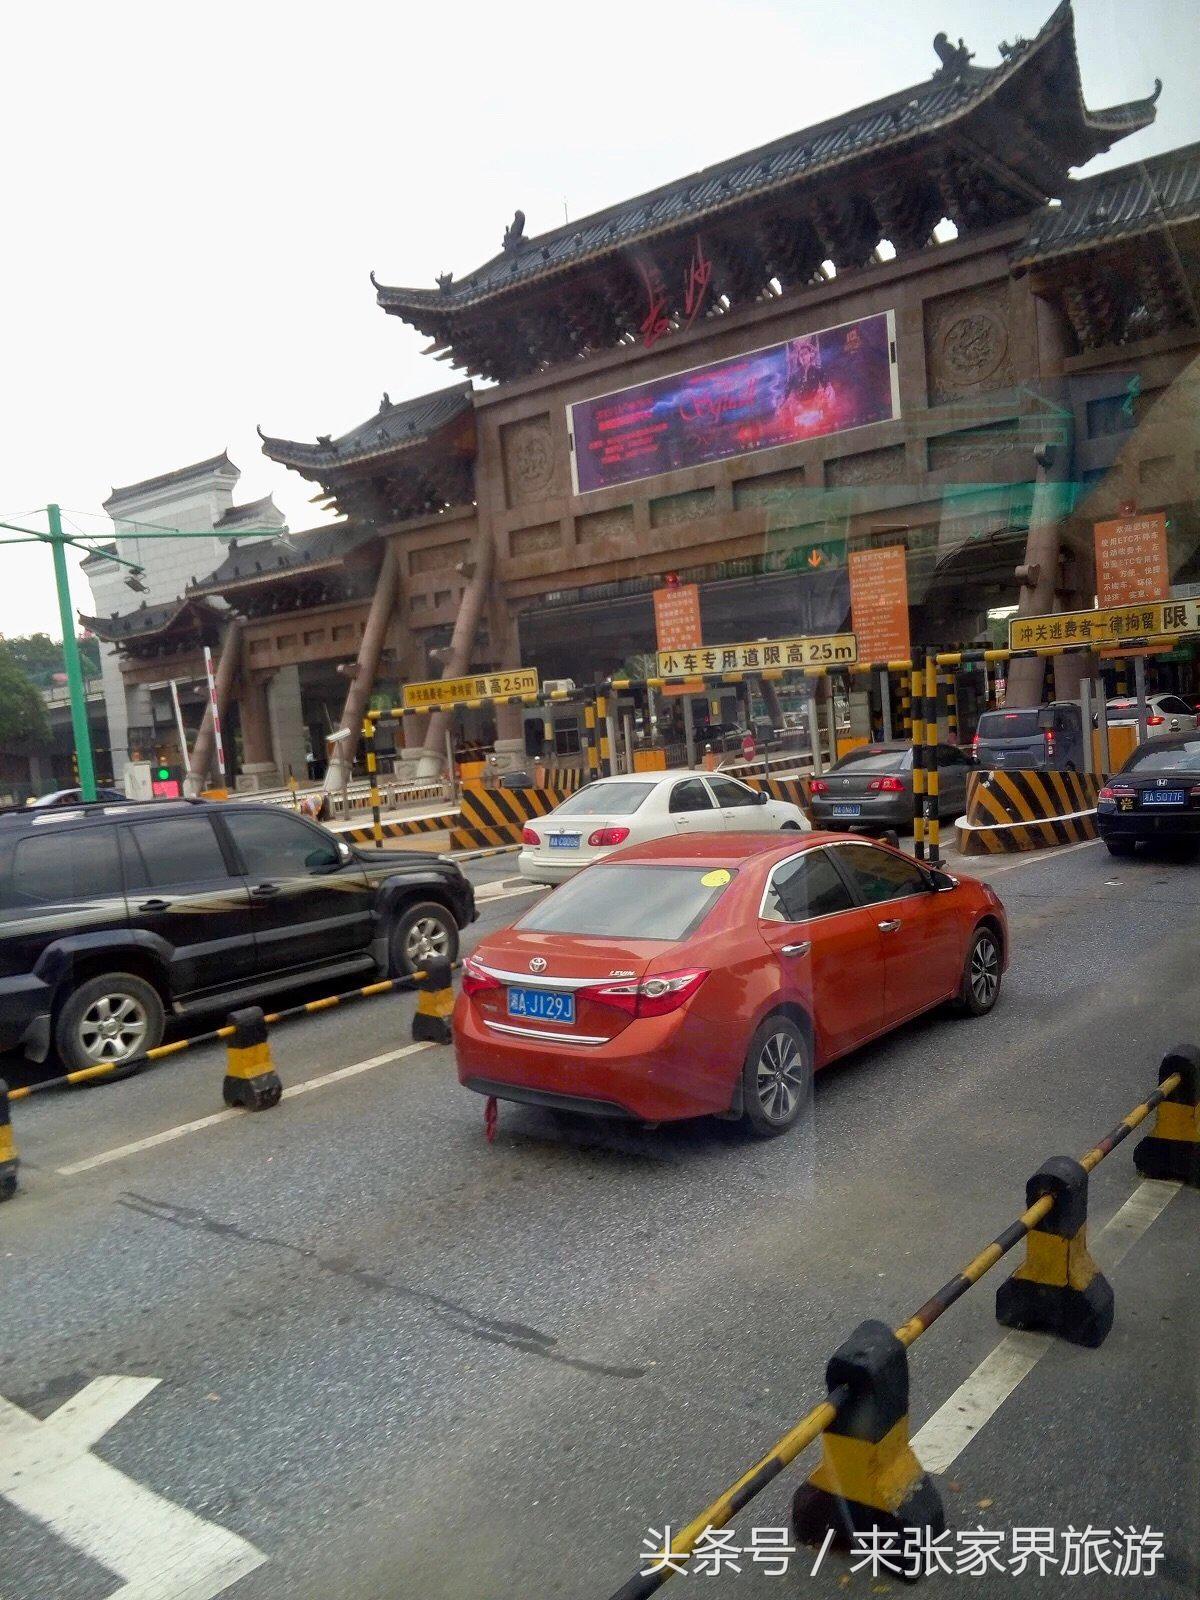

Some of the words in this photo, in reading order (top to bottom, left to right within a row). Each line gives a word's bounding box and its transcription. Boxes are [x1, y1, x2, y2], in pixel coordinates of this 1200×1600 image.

[1020, 611, 1155, 642] 冲关逃费者一律拘留
[1163, 603, 1200, 630] 限
